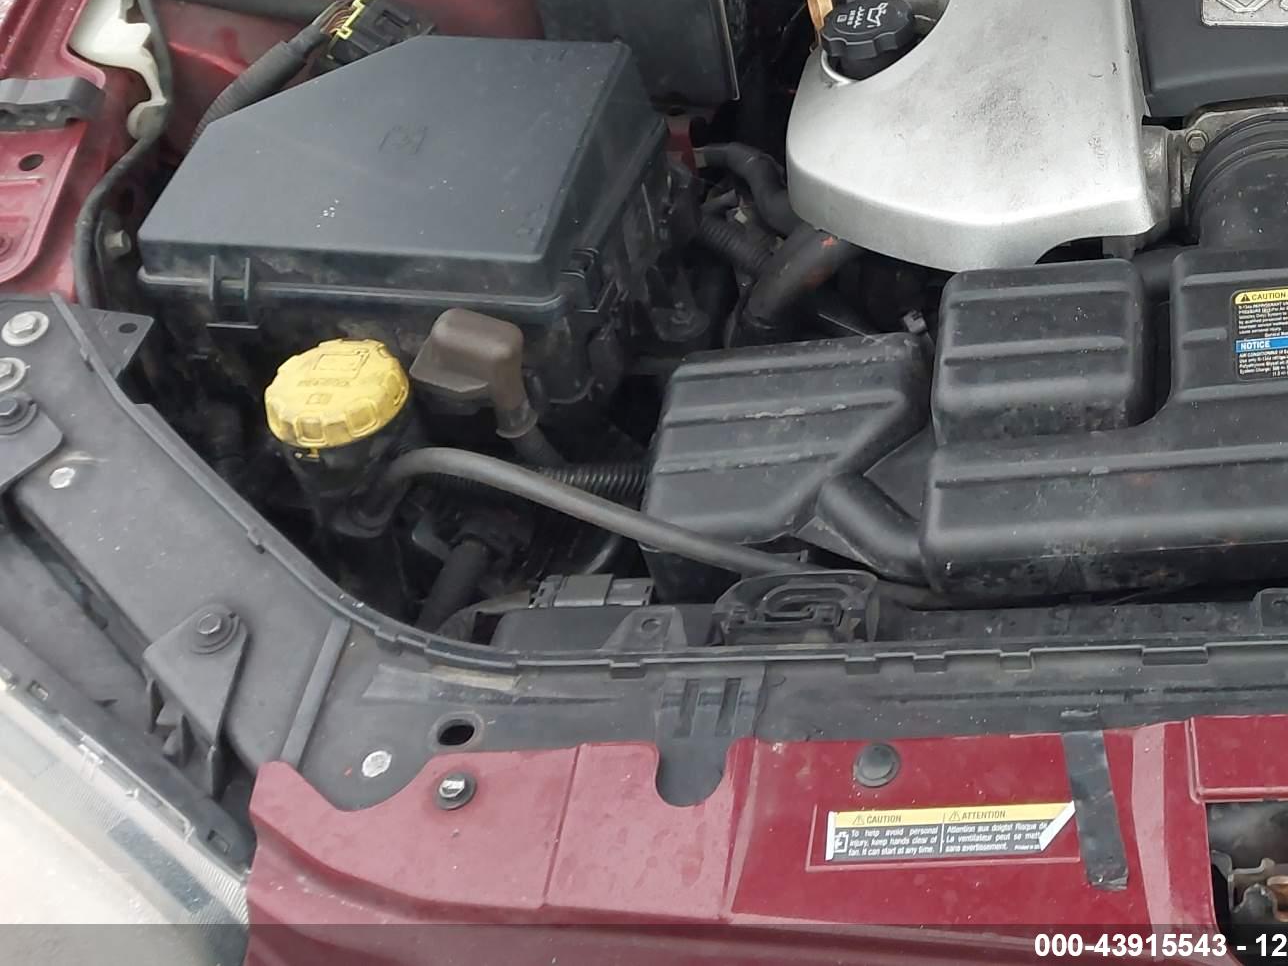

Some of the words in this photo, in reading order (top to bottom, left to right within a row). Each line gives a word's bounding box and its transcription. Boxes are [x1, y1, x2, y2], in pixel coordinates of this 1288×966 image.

[1252, 292, 1286, 301] CAUTION
[1240, 340, 1270, 350] NOTICE
[866, 815, 902, 824] CAUTION
[962, 810, 1006, 820] ATTENTION
[865, 829, 880, 838] help
[886, 828, 904, 836] avoid
[910, 826, 938, 835] personal
[946, 824, 976, 833] Attention
[872, 837, 888, 846] keep
[890, 836, 910, 845] hands
[912, 836, 928, 844] clear
[930, 836, 938, 844] of
[946, 835, 954, 843] Le
[1025, 832, 1040, 840] mett
[868, 848, 880, 856] can
[882, 847, 896, 855] start
[904, 847, 917, 856] any
